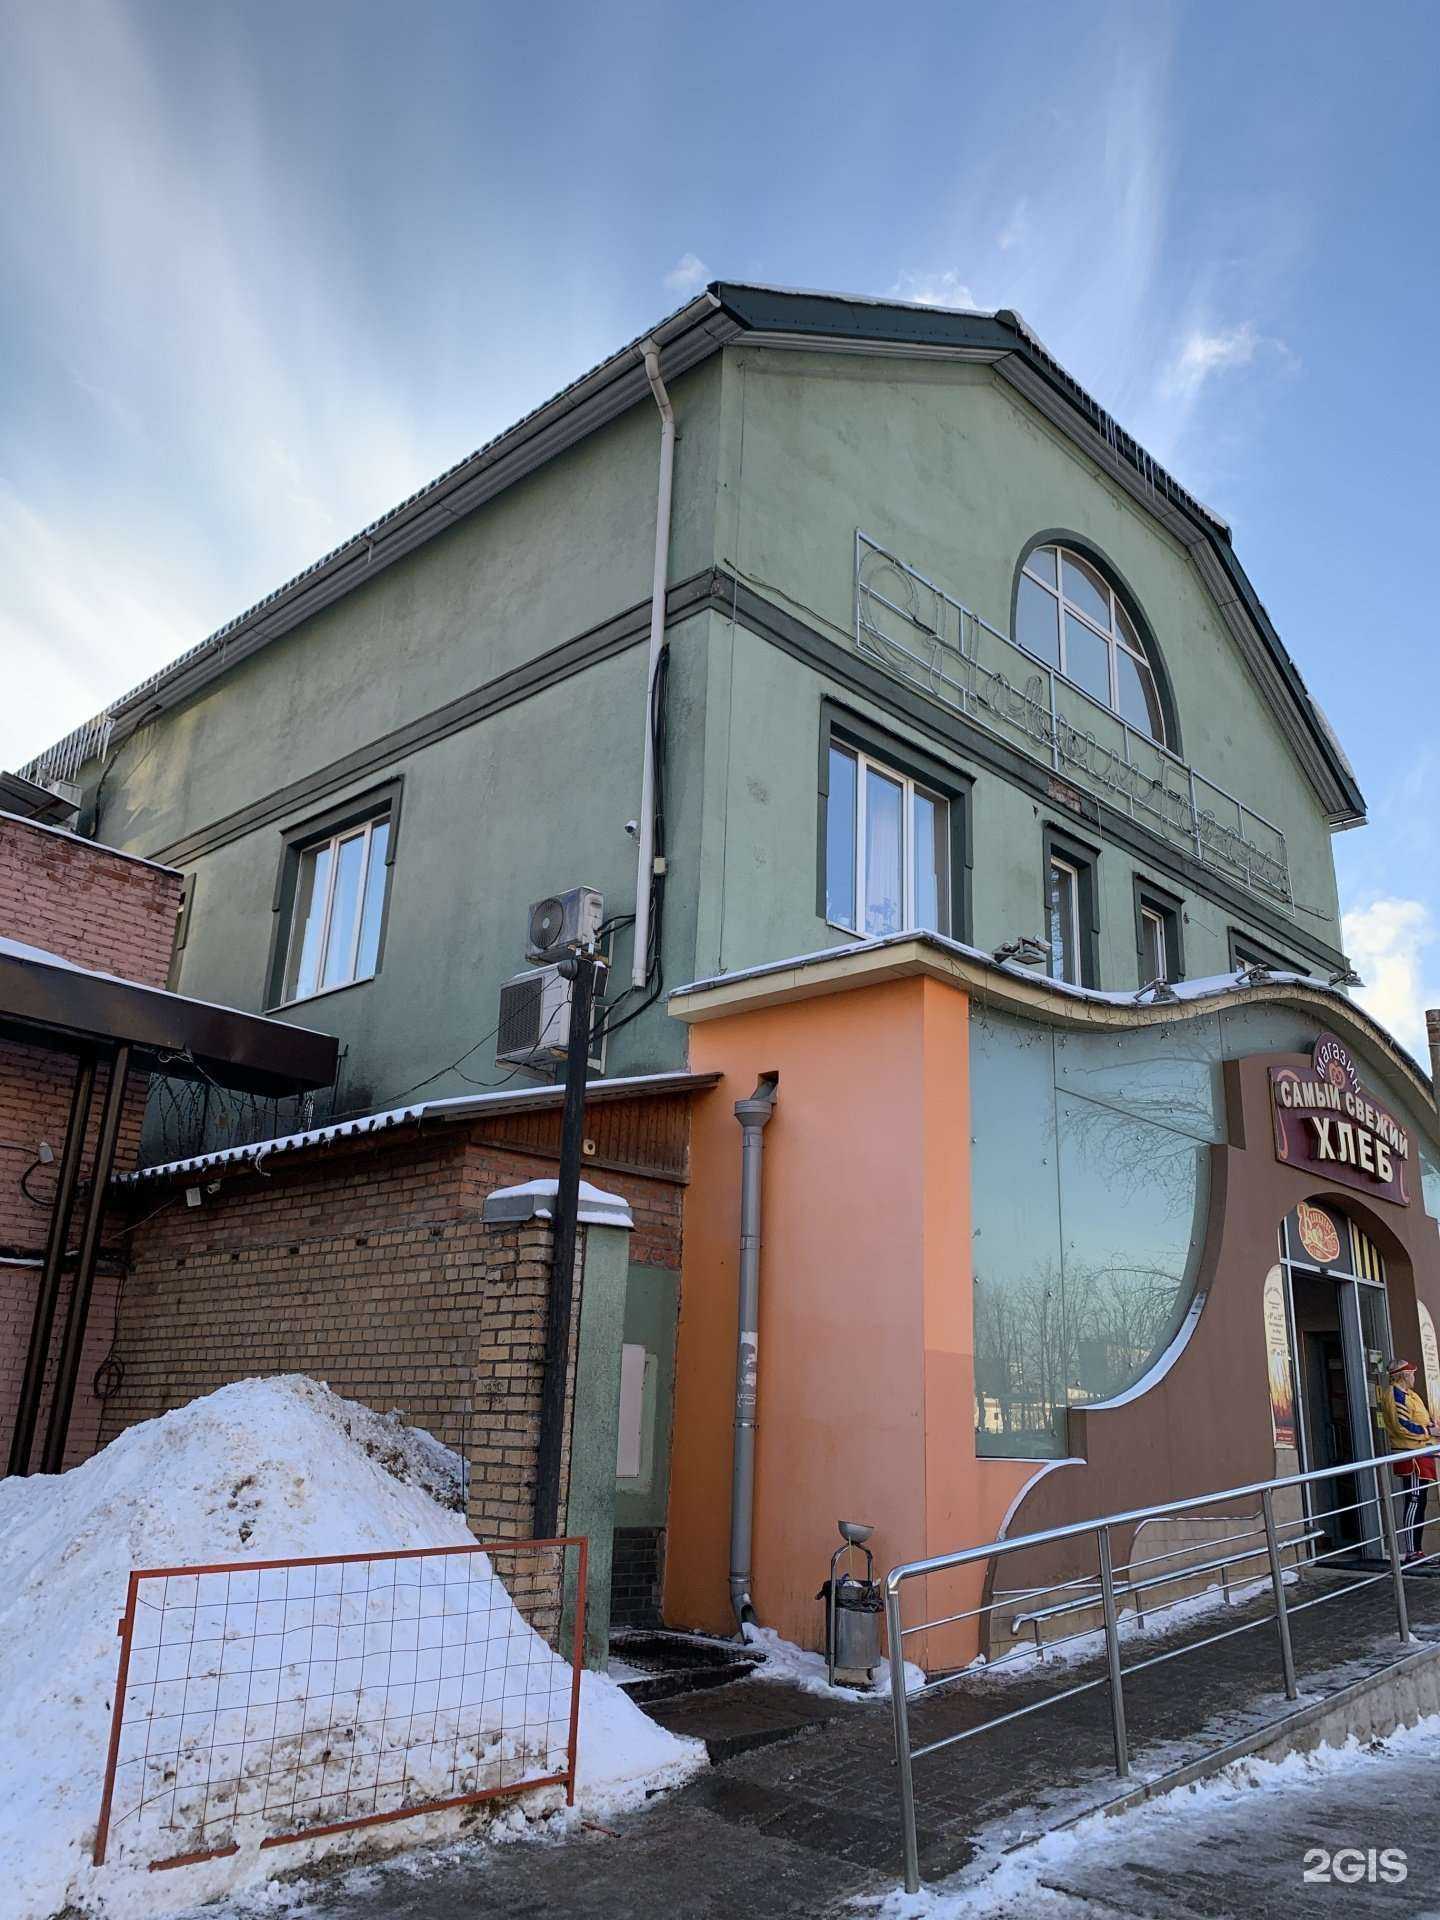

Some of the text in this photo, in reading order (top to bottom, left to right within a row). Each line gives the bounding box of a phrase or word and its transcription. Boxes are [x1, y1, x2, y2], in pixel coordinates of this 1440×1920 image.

[1316, 1042, 1361, 1094] магазин
[1312, 1116, 1393, 1184] ХЛЕБ
[1345, 1092, 1409, 1161] СВЕЖИЙ
